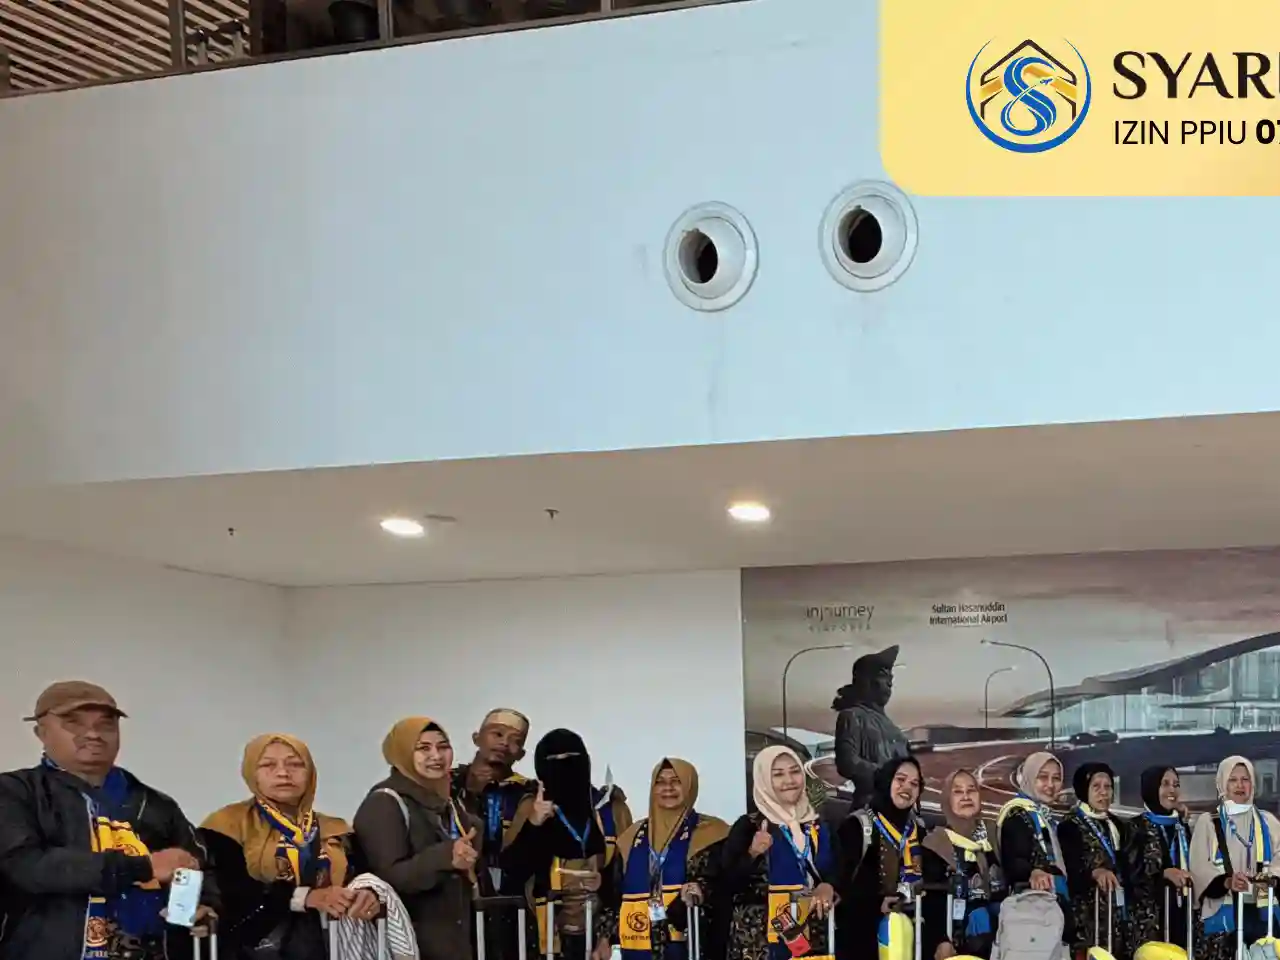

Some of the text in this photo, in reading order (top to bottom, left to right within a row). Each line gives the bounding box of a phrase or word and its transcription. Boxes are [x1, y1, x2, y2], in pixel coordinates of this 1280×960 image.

[931, 603, 957, 614] Sultan
[929, 612, 1008, 626] International Airport
